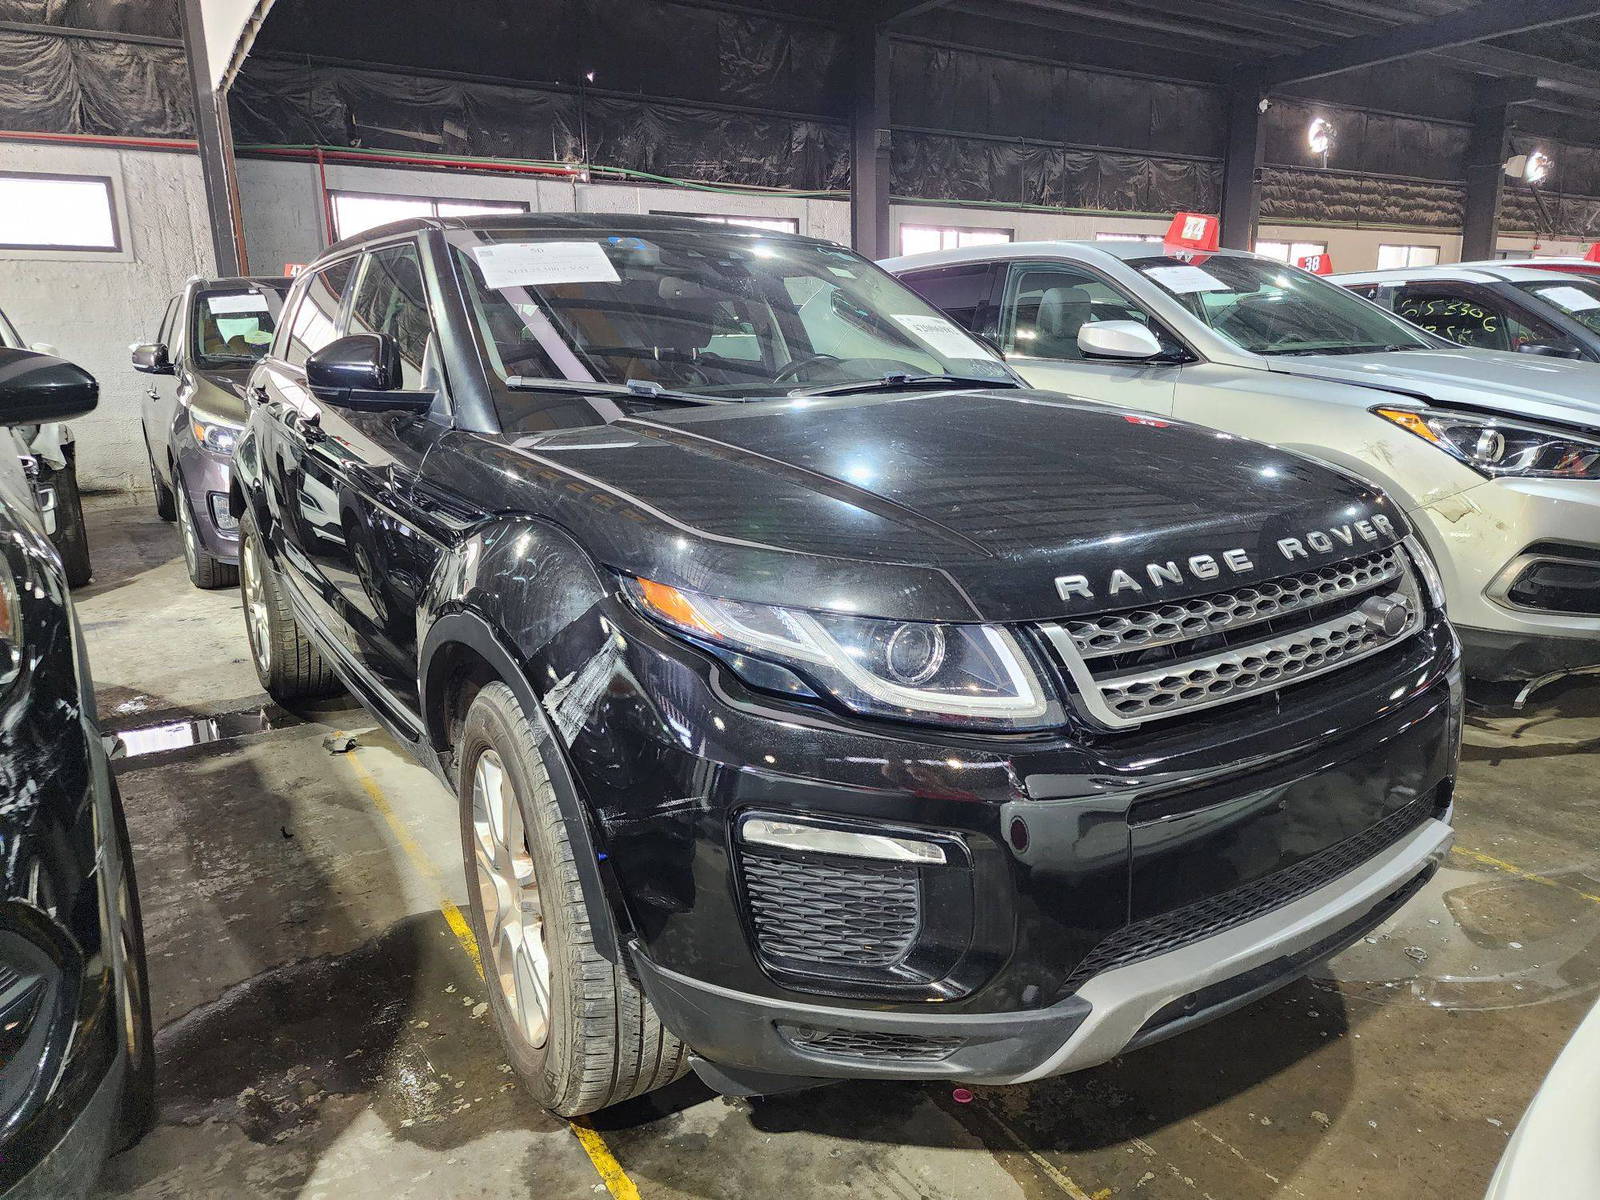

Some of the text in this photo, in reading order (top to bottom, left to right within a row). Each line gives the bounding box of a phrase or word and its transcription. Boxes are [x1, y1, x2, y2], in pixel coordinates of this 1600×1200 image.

[1182, 217, 1206, 240] 44
[1304, 256, 1320, 272] 38
[1054, 513, 1395, 602] RANGE ROVER
